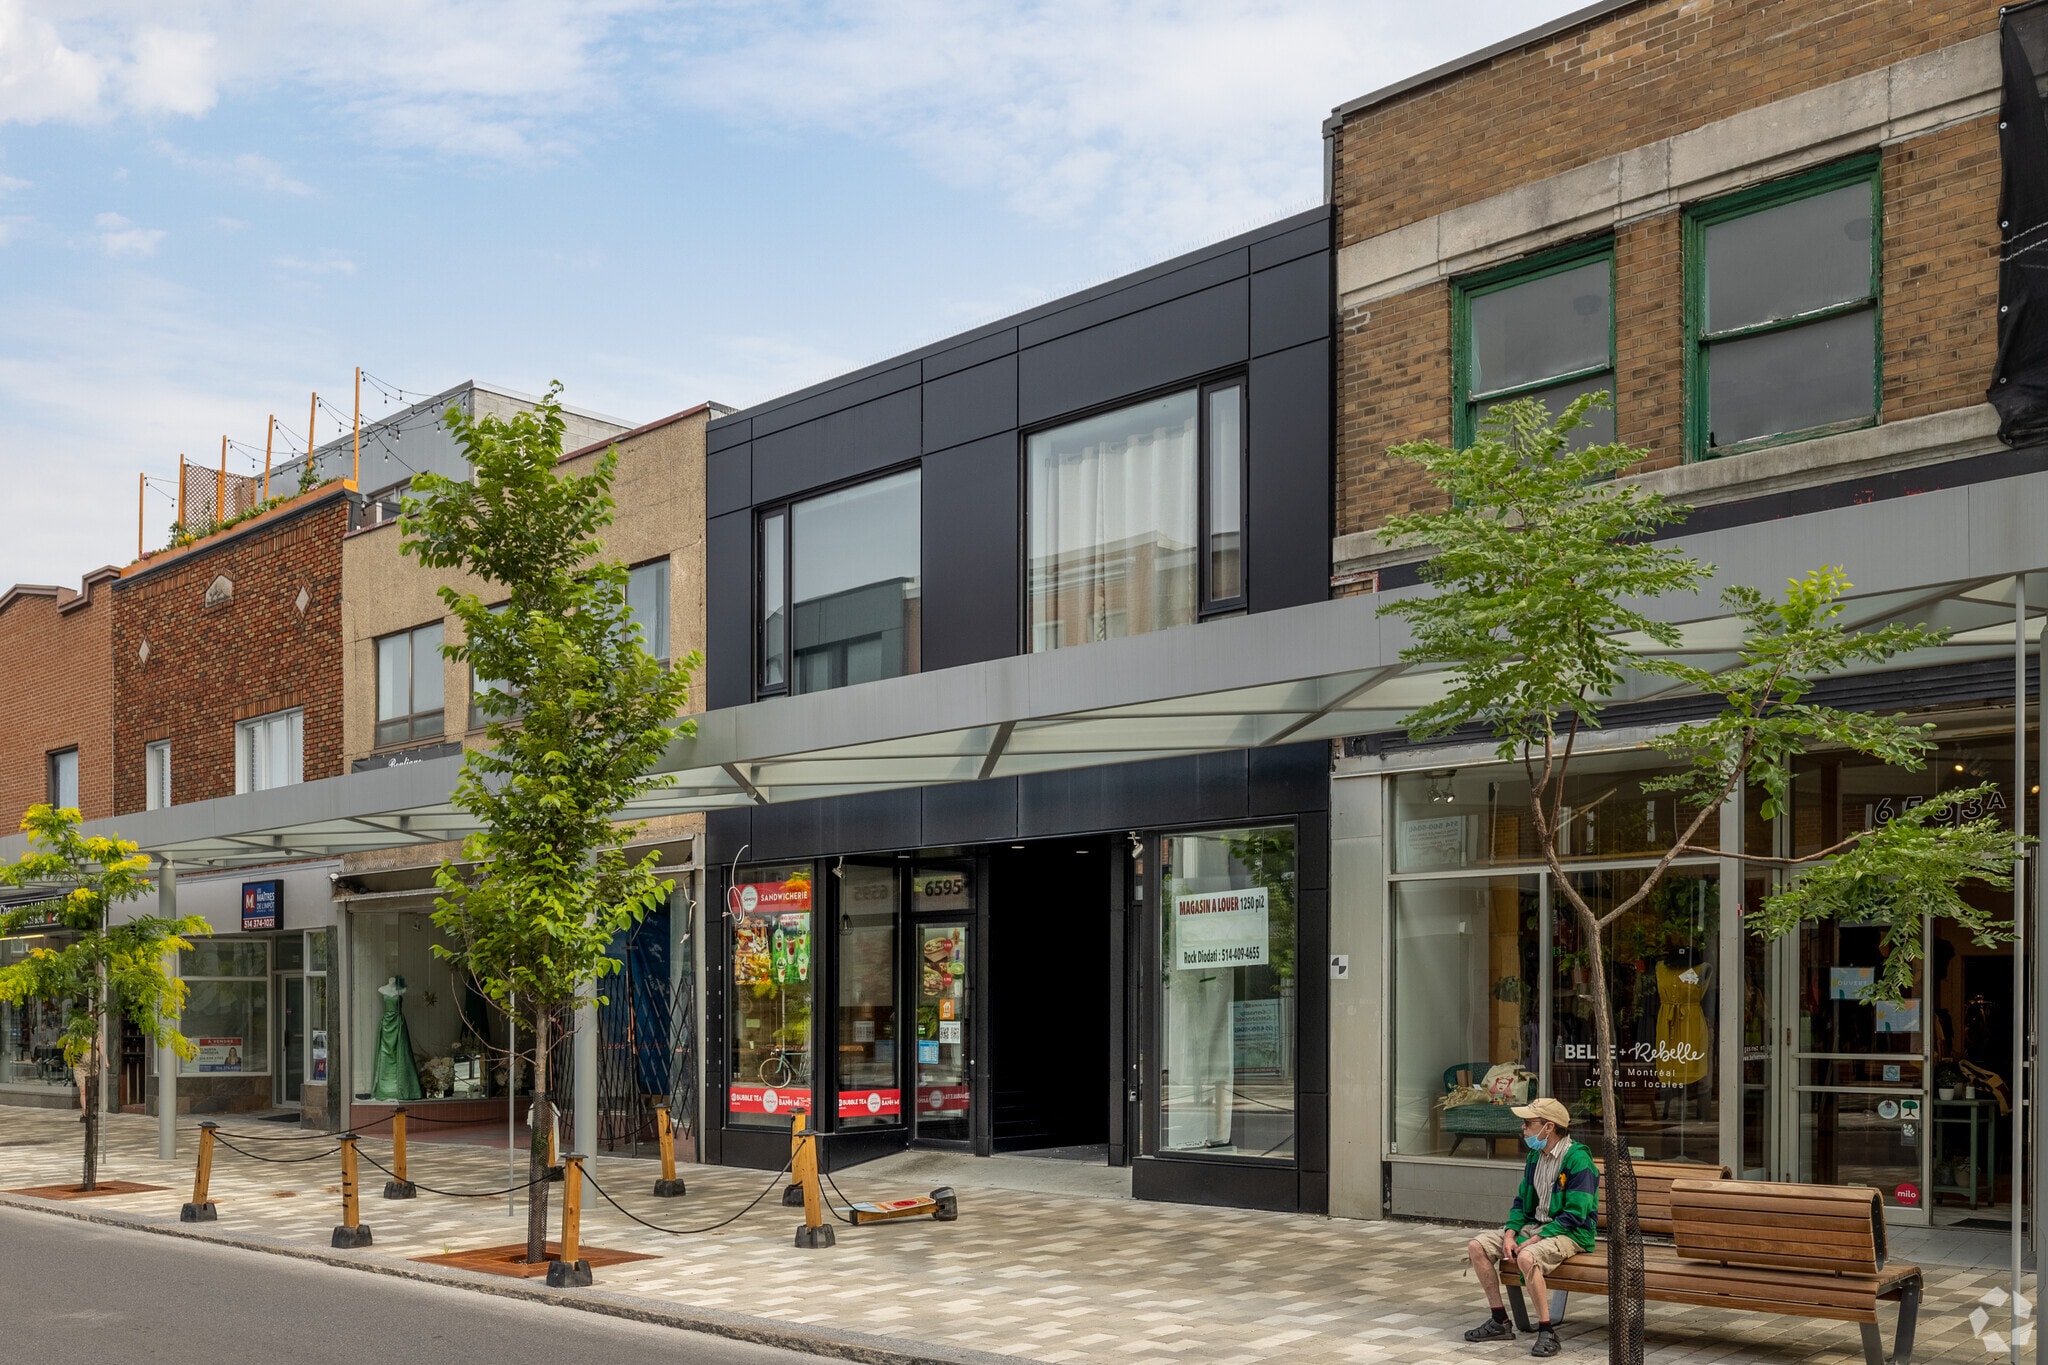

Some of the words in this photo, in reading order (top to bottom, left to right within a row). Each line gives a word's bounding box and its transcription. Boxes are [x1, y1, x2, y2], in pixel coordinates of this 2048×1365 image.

[925, 879, 963, 897] 6595
[760, 891, 808, 902] SANDWICHERIE
[1180, 899, 1211, 916] MAGASIN
[1211, 898, 1217, 913] A
[1217, 896, 1239, 912] LOUER
[1240, 896, 1254, 910] 1250
[1256, 895, 1265, 912] pi2
[244, 920, 253, 929] 514
[1183, 950, 1197, 964] Rock
[1197, 949, 1218, 963] Diodati
[1221, 946, 1260, 962] 514-409-4655
[1565, 1044, 1617, 1060] BELE
[1628, 1040, 1705, 1064] Rebelle
[1592, 1067, 1620, 1076] Me
[1627, 1067, 1676, 1077] Montréal
[1584, 1078, 1637, 1088] Créions
[1644, 1079, 1684, 1089] locales
[736, 1094, 753, 1102] BUBBLE
[753, 1094, 763, 1102] TEA
[1897, 1190, 1917, 1198] milo
